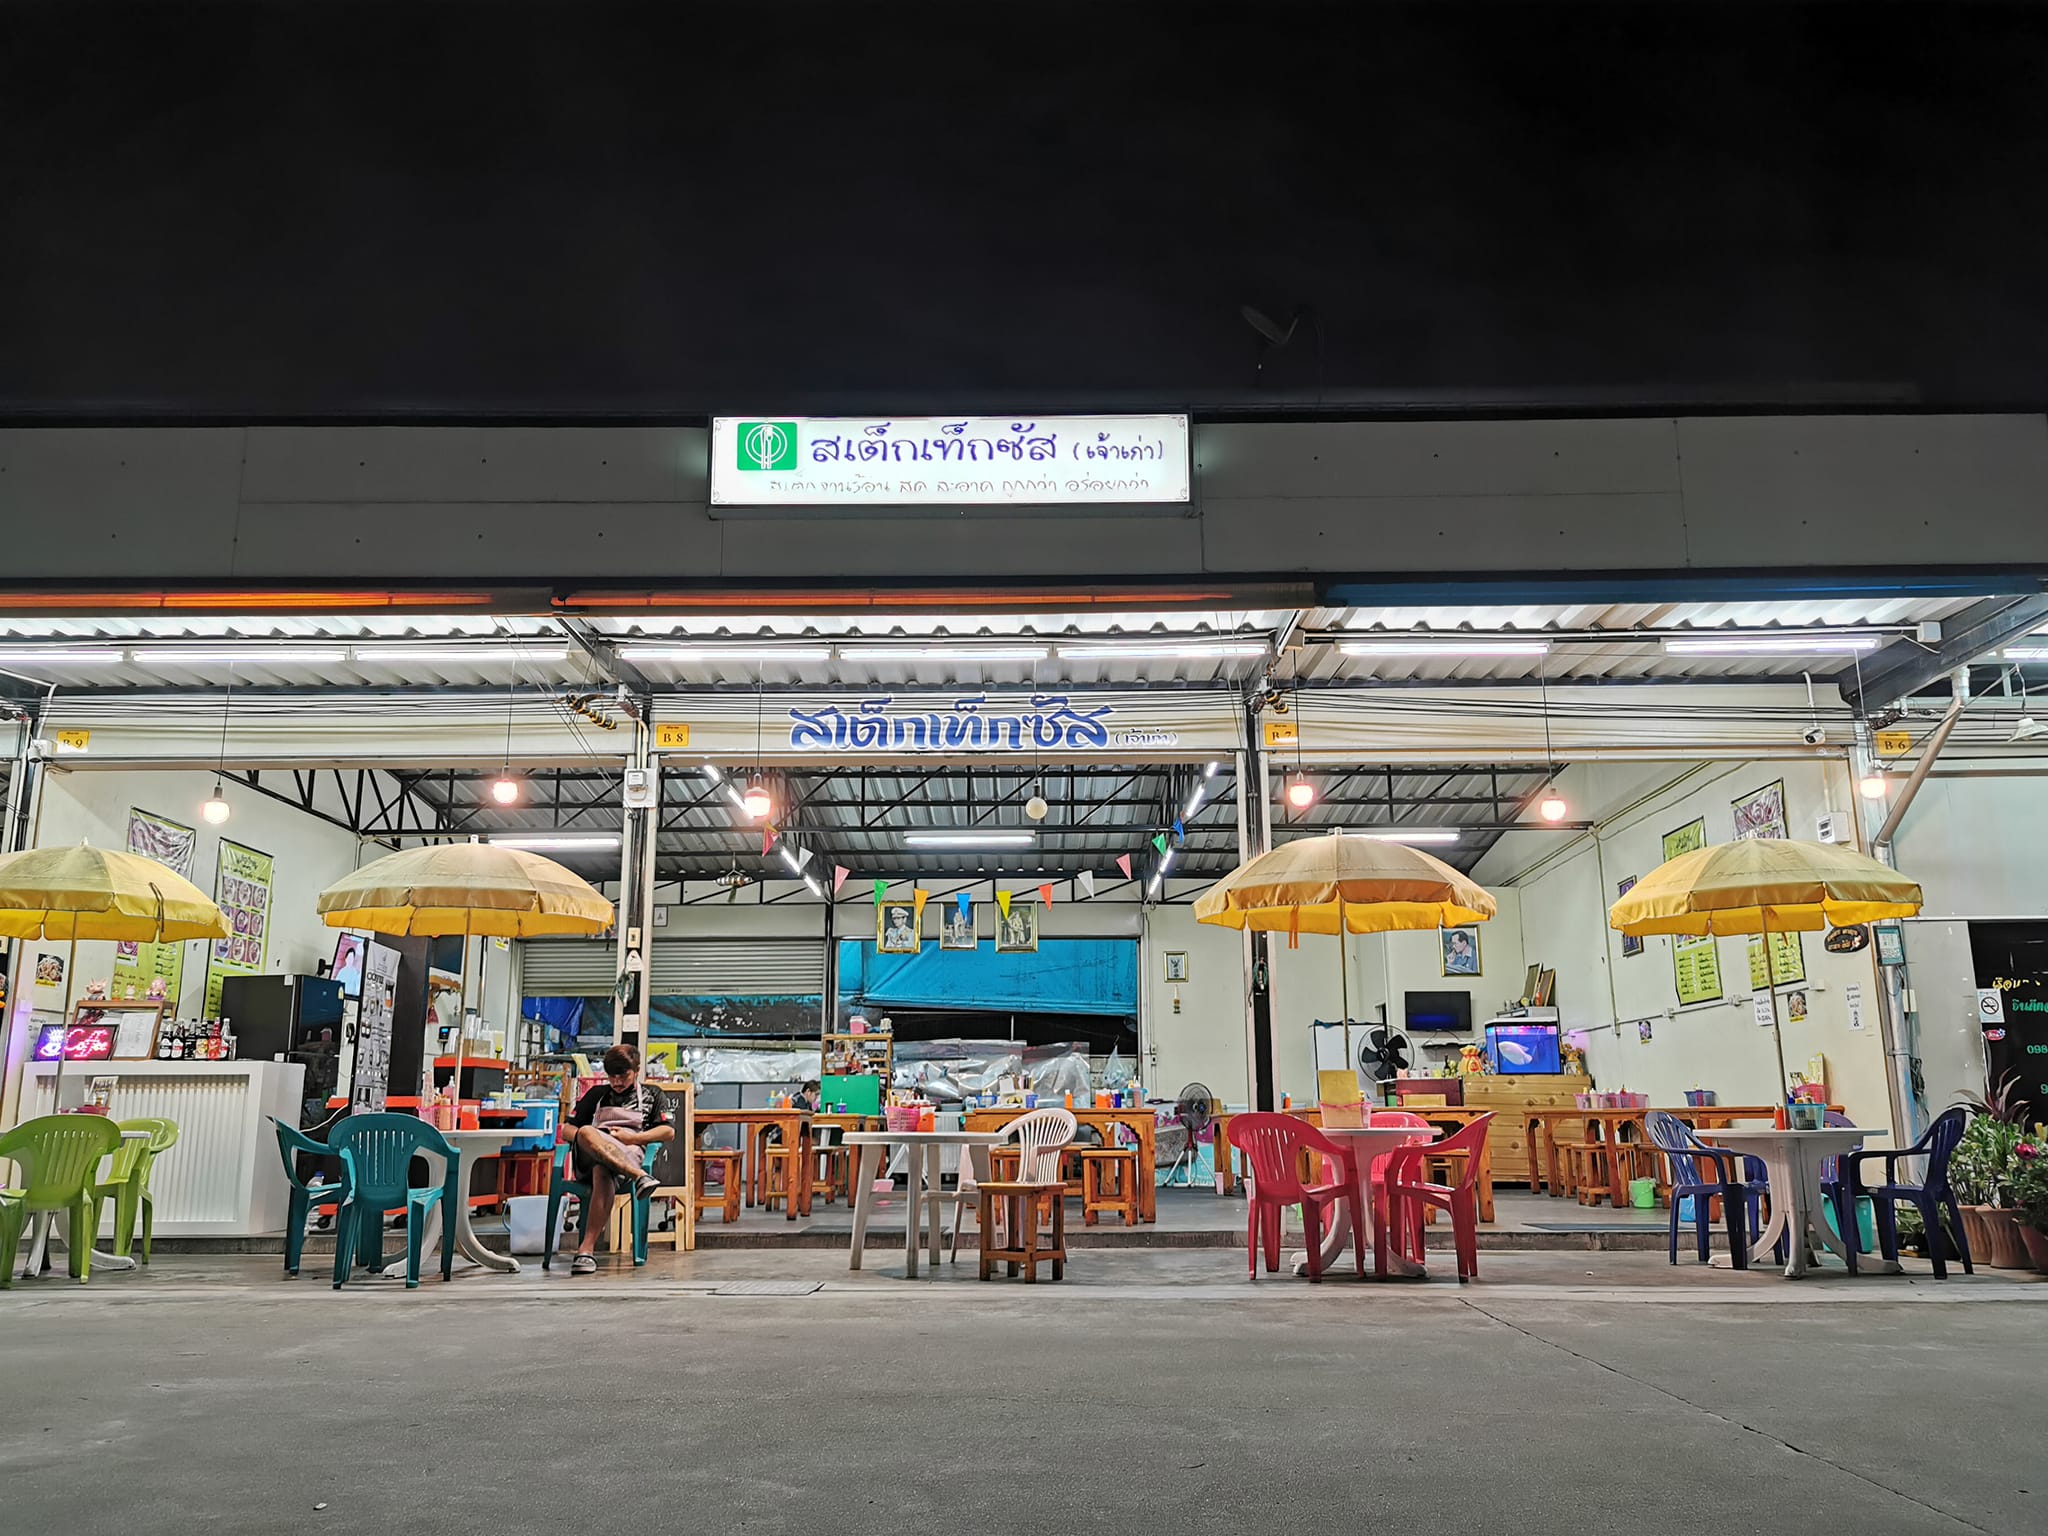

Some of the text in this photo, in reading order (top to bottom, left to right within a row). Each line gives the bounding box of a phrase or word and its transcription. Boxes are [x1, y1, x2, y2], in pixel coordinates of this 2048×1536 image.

[811, 422, 1057, 462] สเต็กเท็กซัส
[789, 693, 1115, 750] สเต็กเท็กซัส
